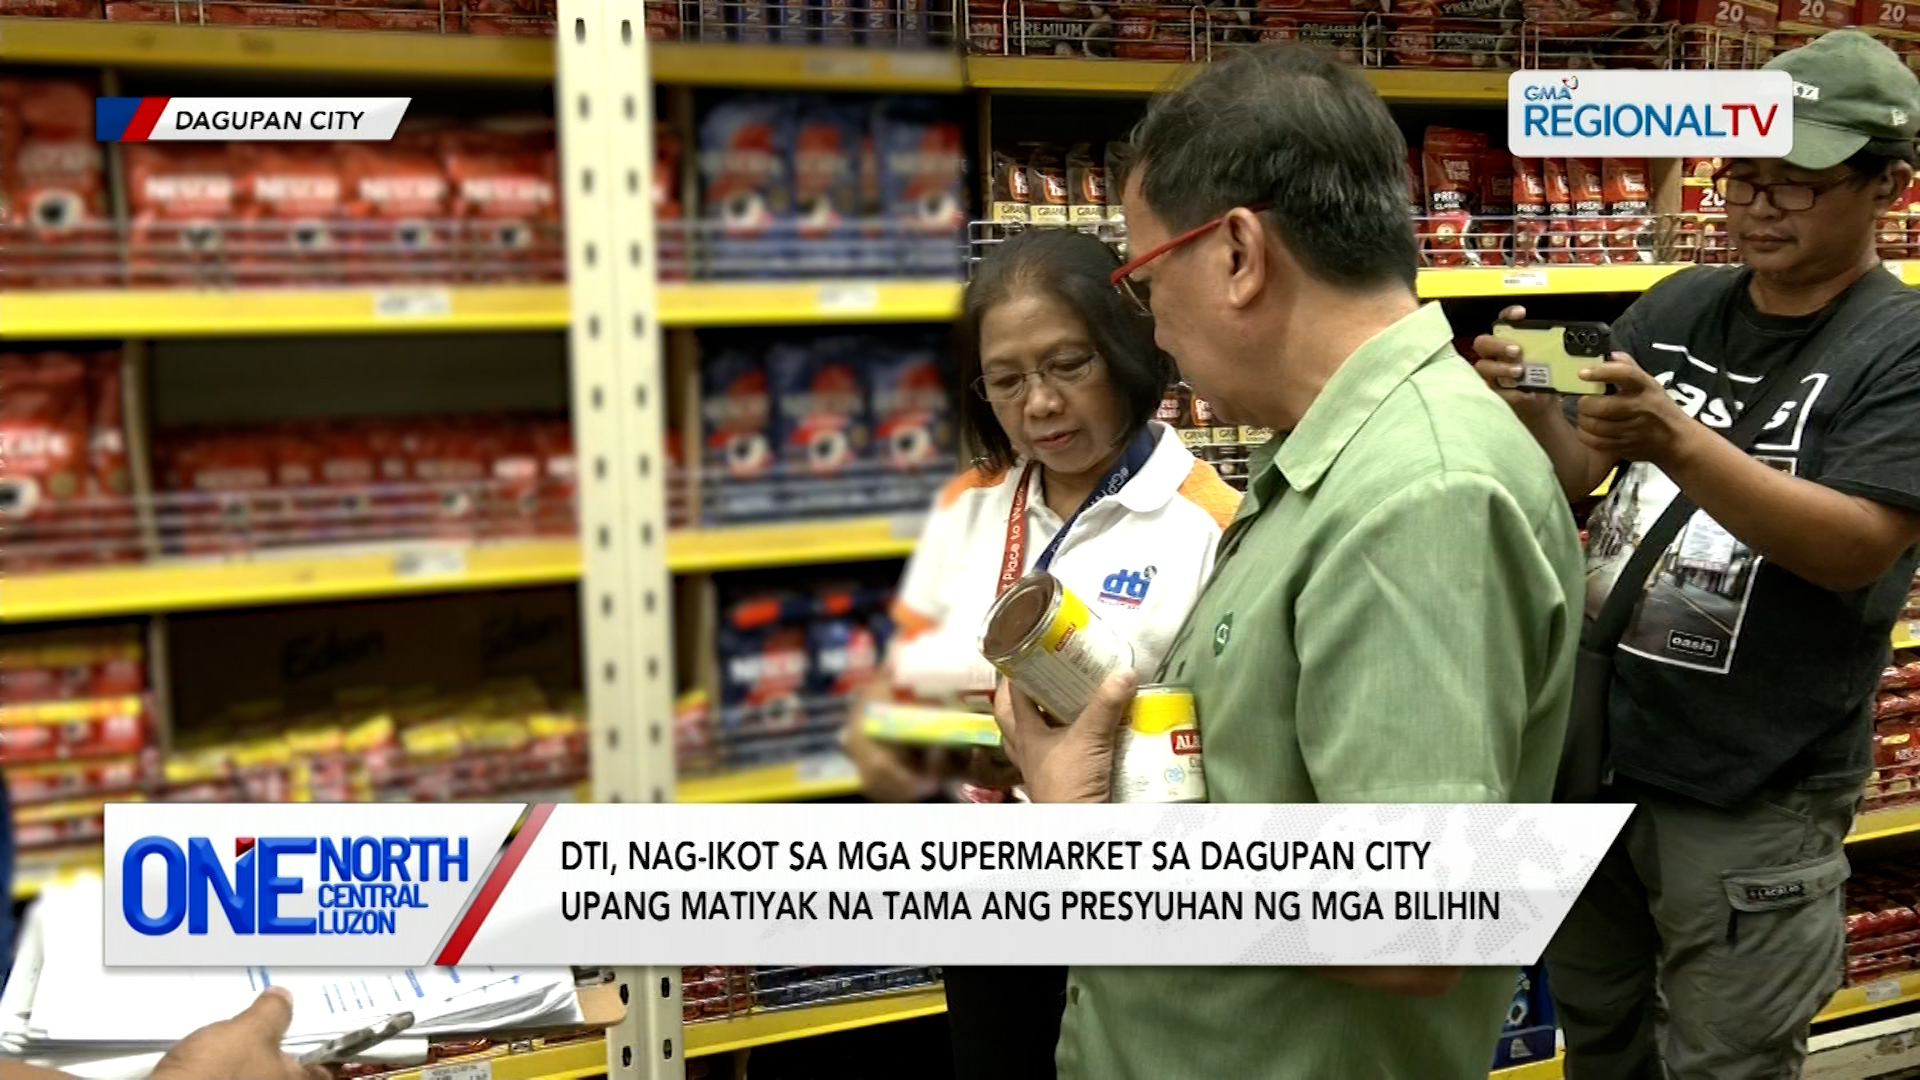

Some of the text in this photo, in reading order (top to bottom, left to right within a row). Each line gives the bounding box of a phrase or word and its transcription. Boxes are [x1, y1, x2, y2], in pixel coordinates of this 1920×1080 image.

[1716, 4, 1744, 22] 20
[1800, 0, 1825, 17] 20
[1880, 4, 1905, 21] 20
[1009, 525, 1021, 541] to
[1002, 542, 1021, 581] Place
[1102, 566, 1157, 600] dti
[1672, 636, 1713, 653] oasis
